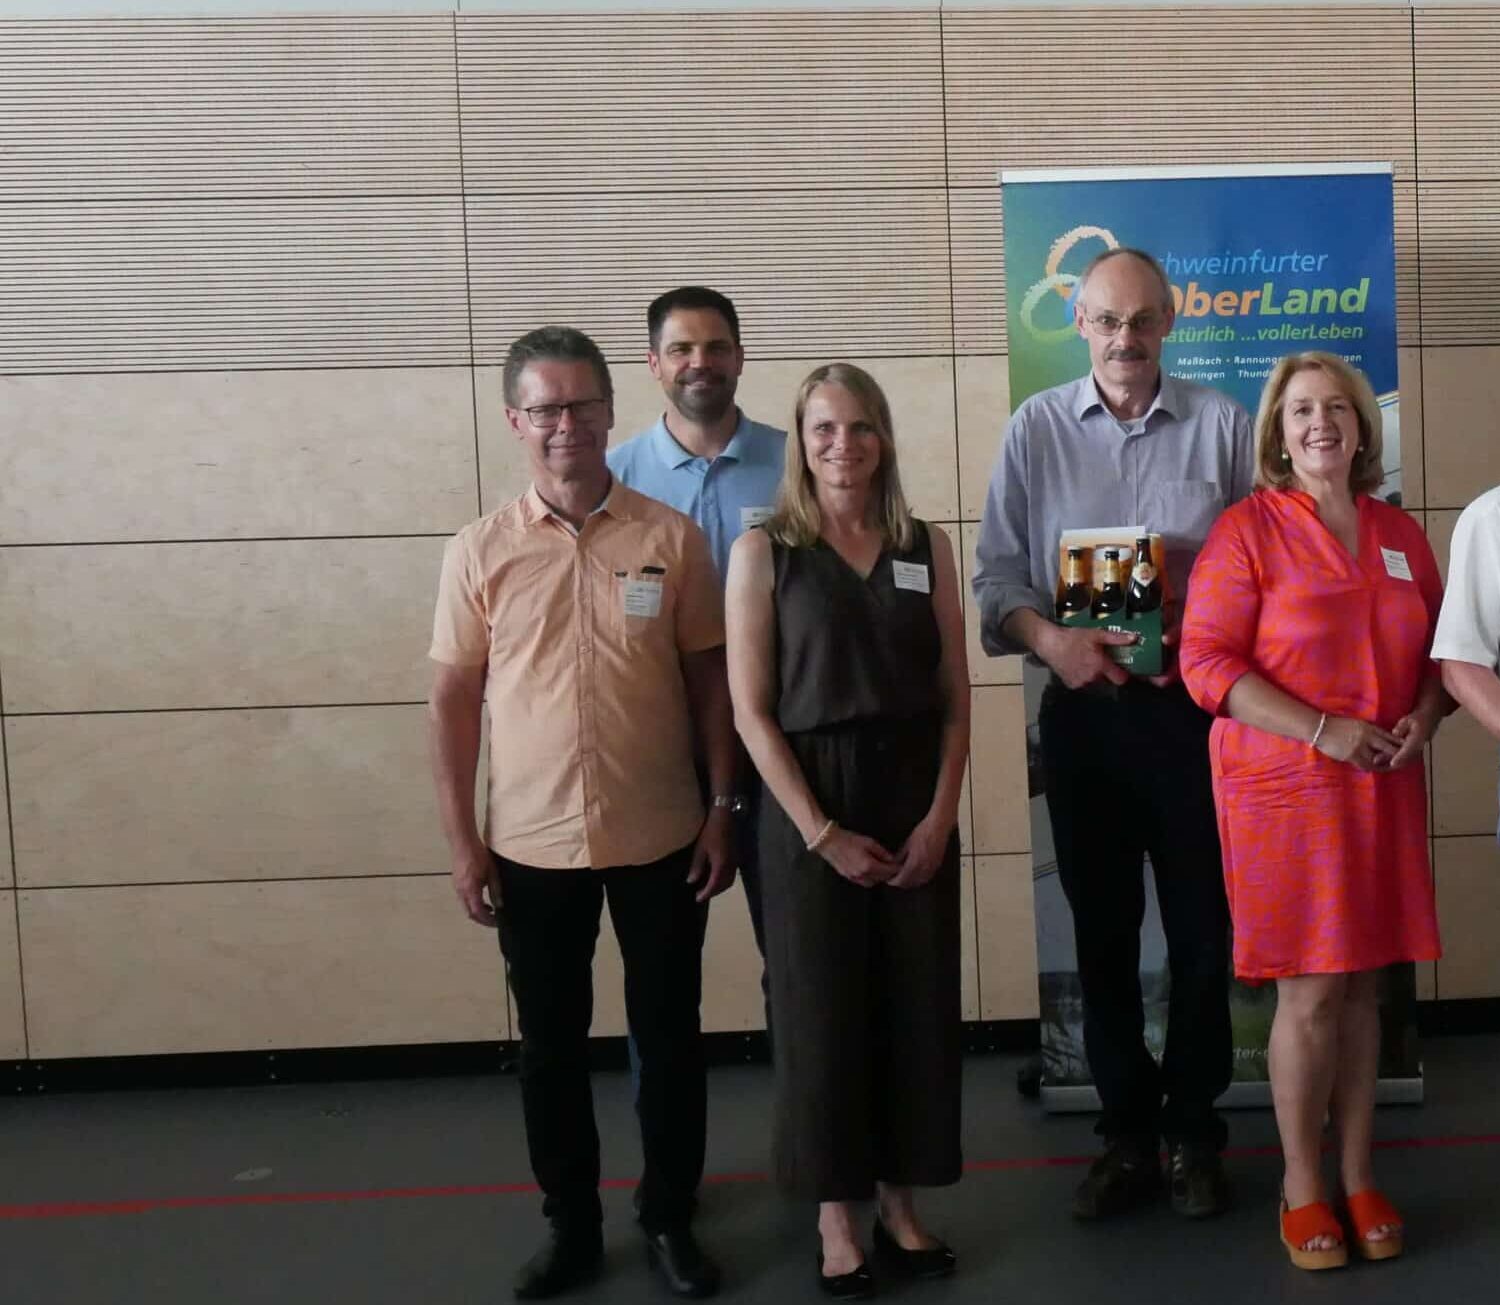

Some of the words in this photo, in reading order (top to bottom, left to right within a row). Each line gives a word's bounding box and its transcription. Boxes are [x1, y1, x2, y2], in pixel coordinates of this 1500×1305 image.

[1158, 249, 1329, 276] hweinfurter
[1162, 325, 1235, 344] atürlich
[1233, 355, 1279, 366] Rannung
[1238, 368, 1272, 379] Thund
